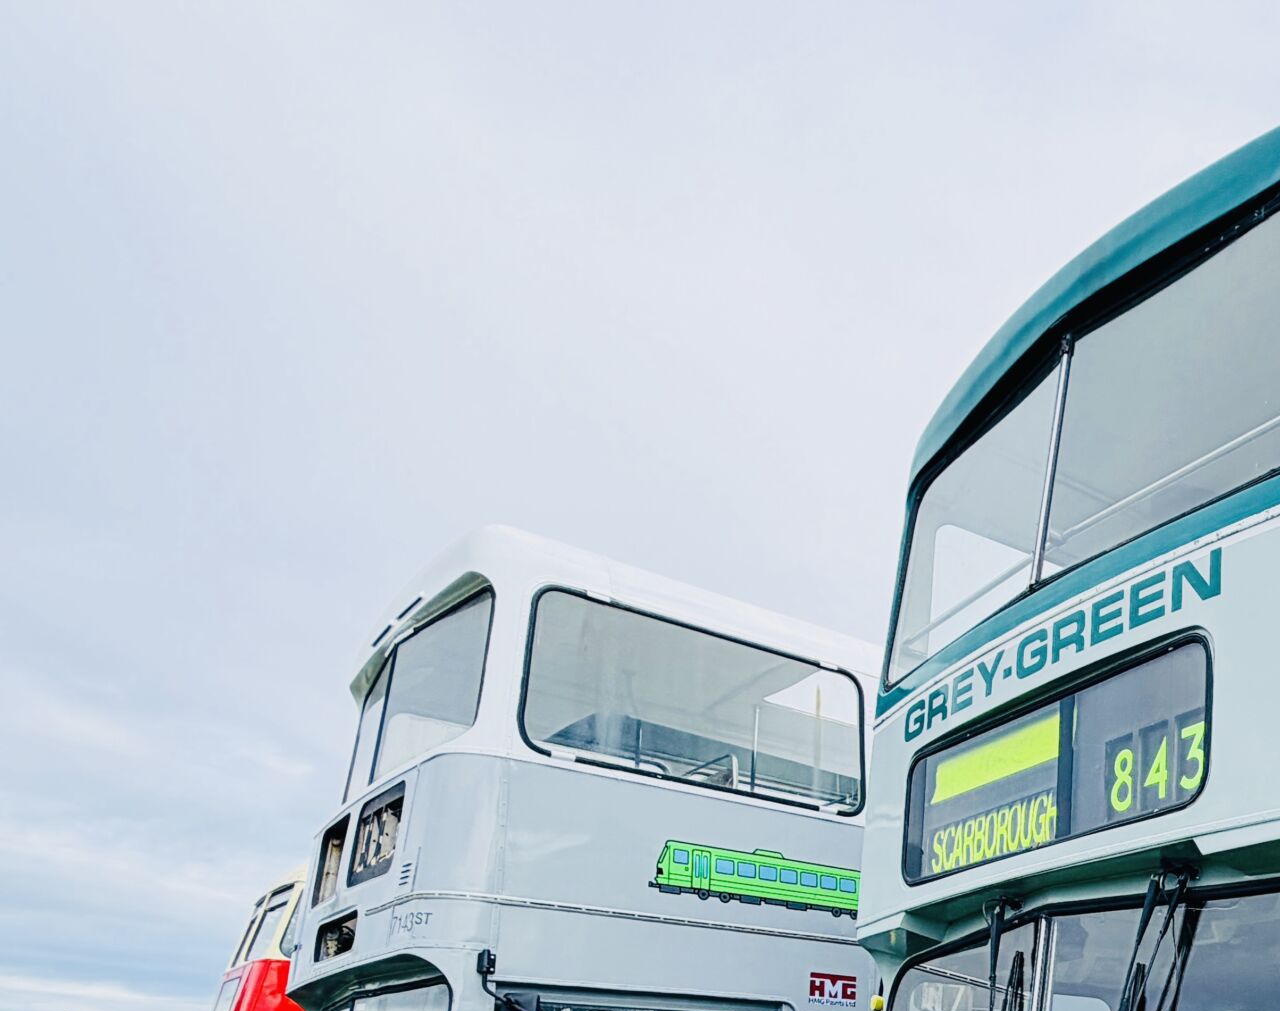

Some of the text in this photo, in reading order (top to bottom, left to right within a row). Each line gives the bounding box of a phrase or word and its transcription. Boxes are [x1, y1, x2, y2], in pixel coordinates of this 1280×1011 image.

[904, 547, 1223, 743] GREY-GREEN
[1110, 720, 1206, 813] 843
[931, 793, 1058, 874] SCARBOROUGH
[808, 997, 825, 1005] HMG
[809, 974, 857, 1000] HMG
